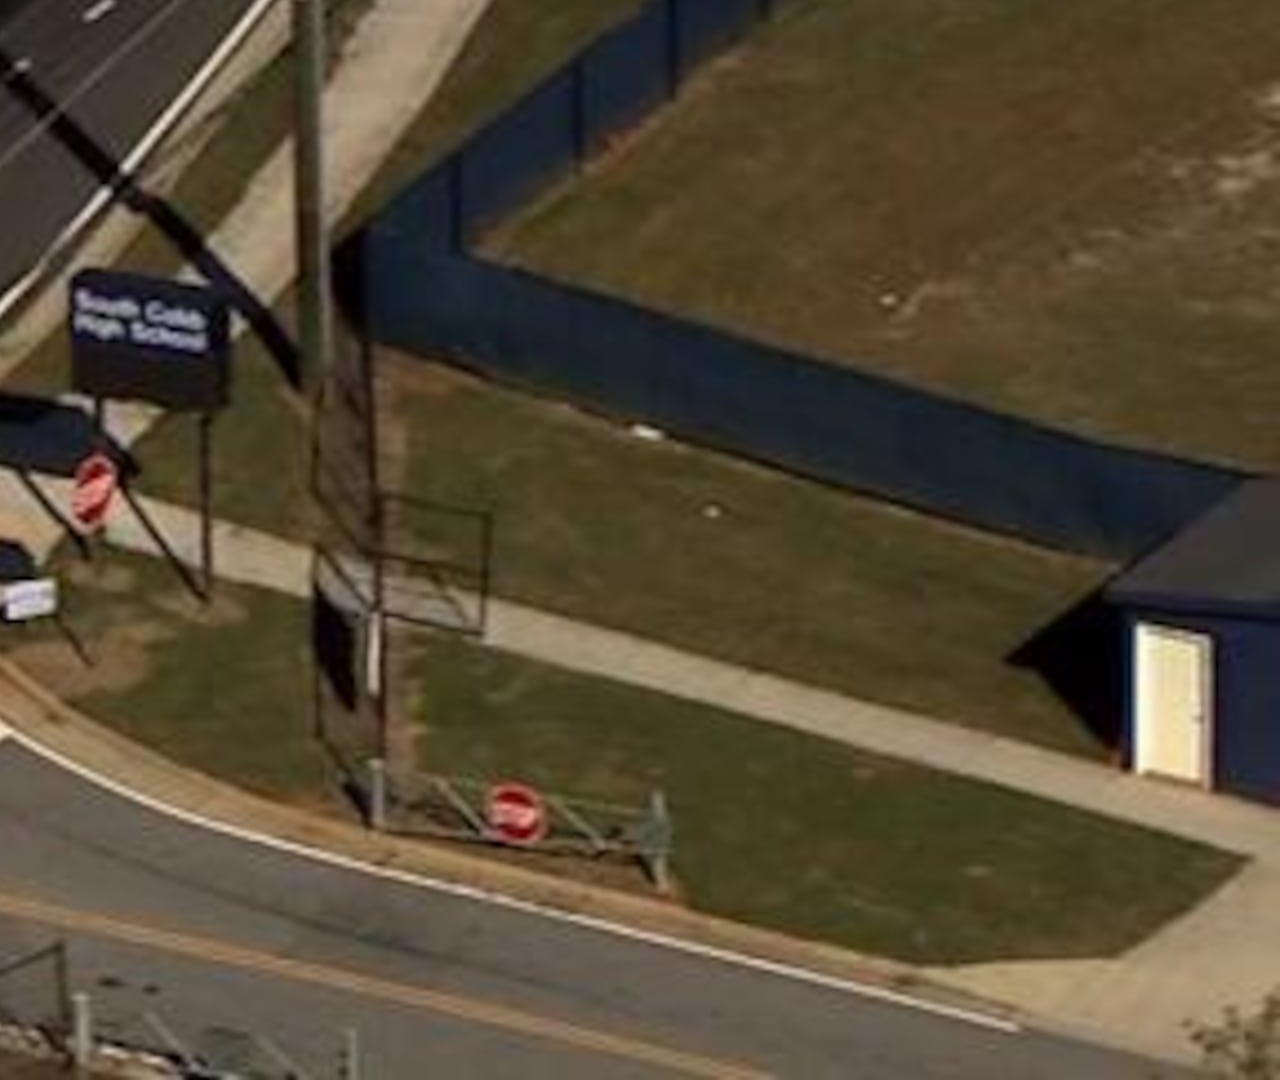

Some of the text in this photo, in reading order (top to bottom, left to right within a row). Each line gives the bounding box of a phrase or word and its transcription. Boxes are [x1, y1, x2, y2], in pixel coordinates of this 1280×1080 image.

[74, 288, 207, 331] South Cobb
[73, 313, 208, 352] High School
